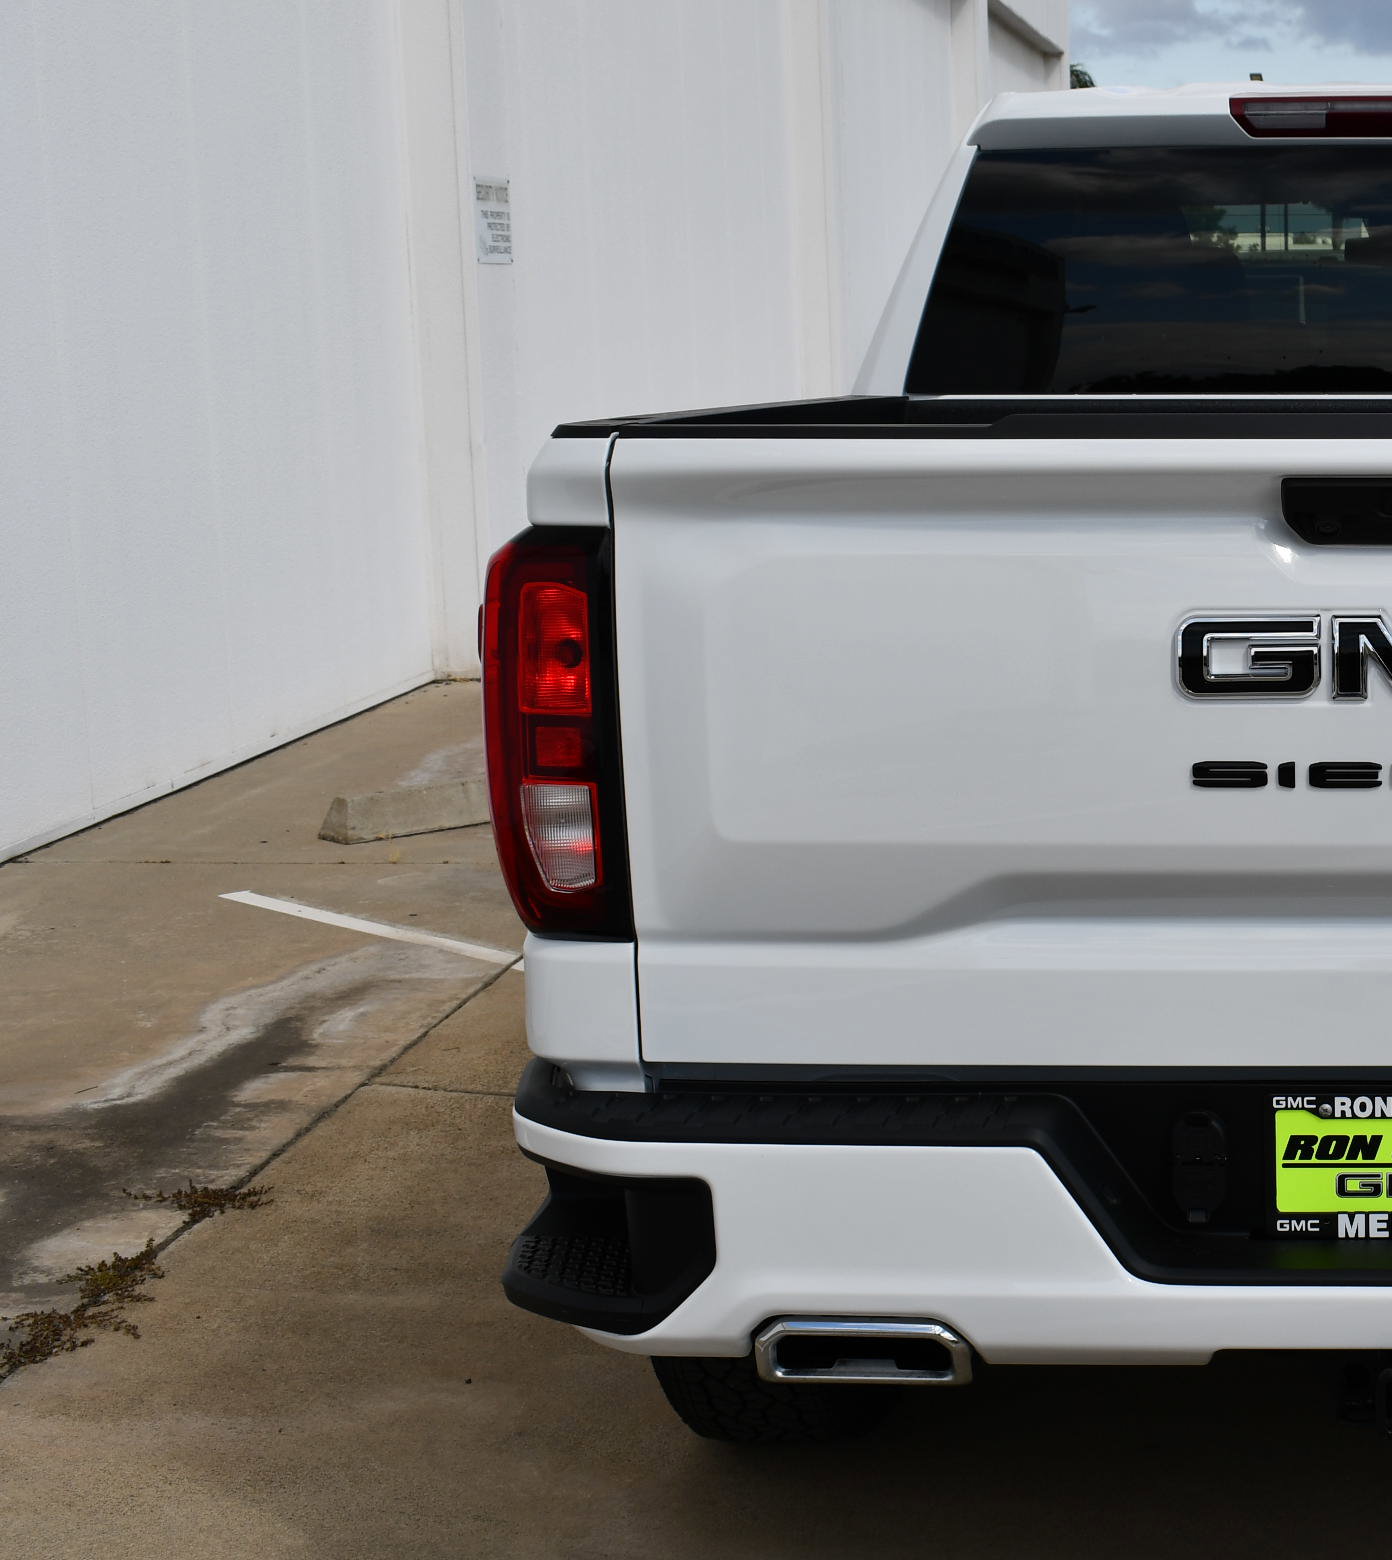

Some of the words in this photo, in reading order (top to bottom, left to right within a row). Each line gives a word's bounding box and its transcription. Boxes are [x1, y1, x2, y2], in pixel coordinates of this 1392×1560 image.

[1272, 1097, 1317, 1109] GMC
[1334, 1096, 1392, 1118] RON
[1282, 1134, 1383, 1161] RON
[1276, 1219, 1320, 1232] GMC
